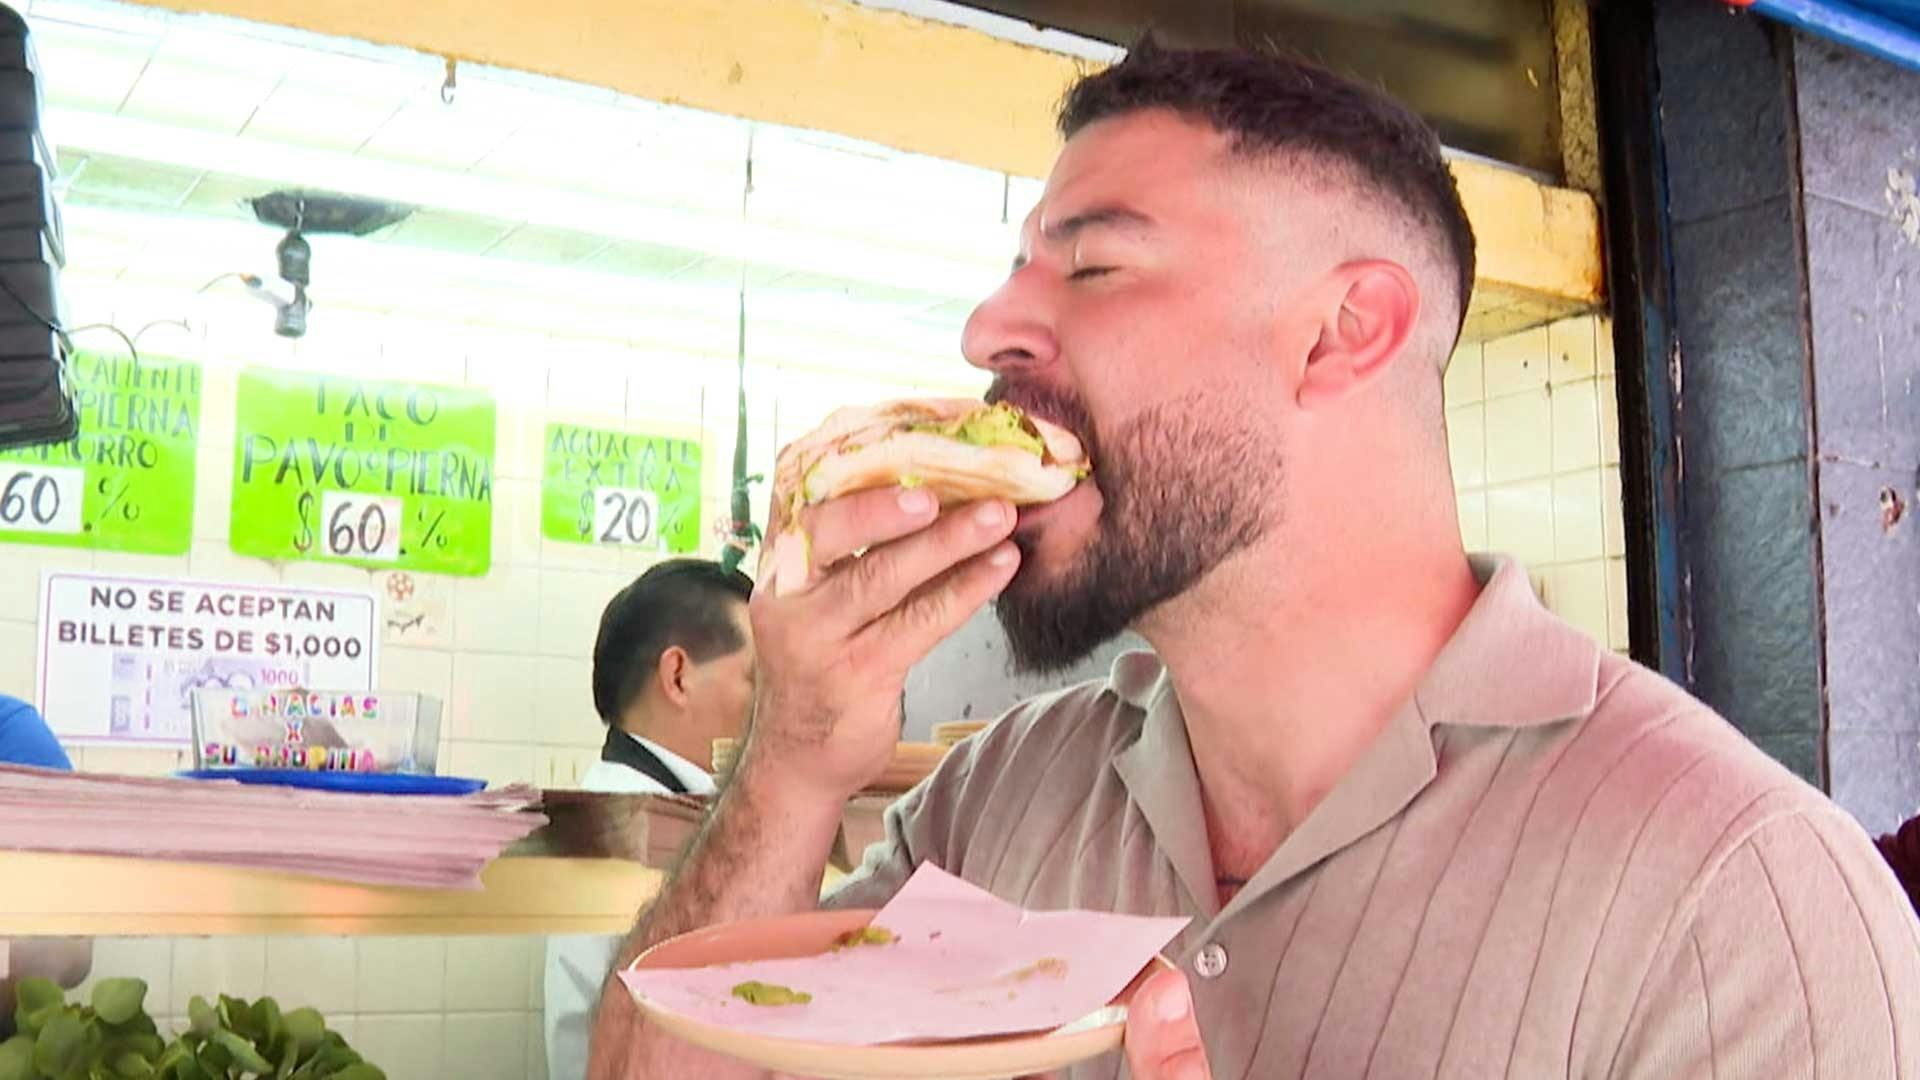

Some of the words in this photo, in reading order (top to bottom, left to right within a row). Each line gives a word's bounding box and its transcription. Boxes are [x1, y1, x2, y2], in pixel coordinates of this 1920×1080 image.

[78, 387, 194, 438] PIERNA
[316, 376, 439, 426] TACO
[242, 433, 362, 489] PAVO
[385, 447, 493, 503] PIERNA
[564, 457, 683, 493] EXTRA
[91, 586, 137, 610] NO
[148, 590, 185, 613] SE
[195, 593, 336, 622] ACEPTAN
[58, 620, 204, 650] BILLETES
[214, 629, 254, 653] DE
[265, 632, 362, 660] $1,000
[204, 741, 237, 766] SU
